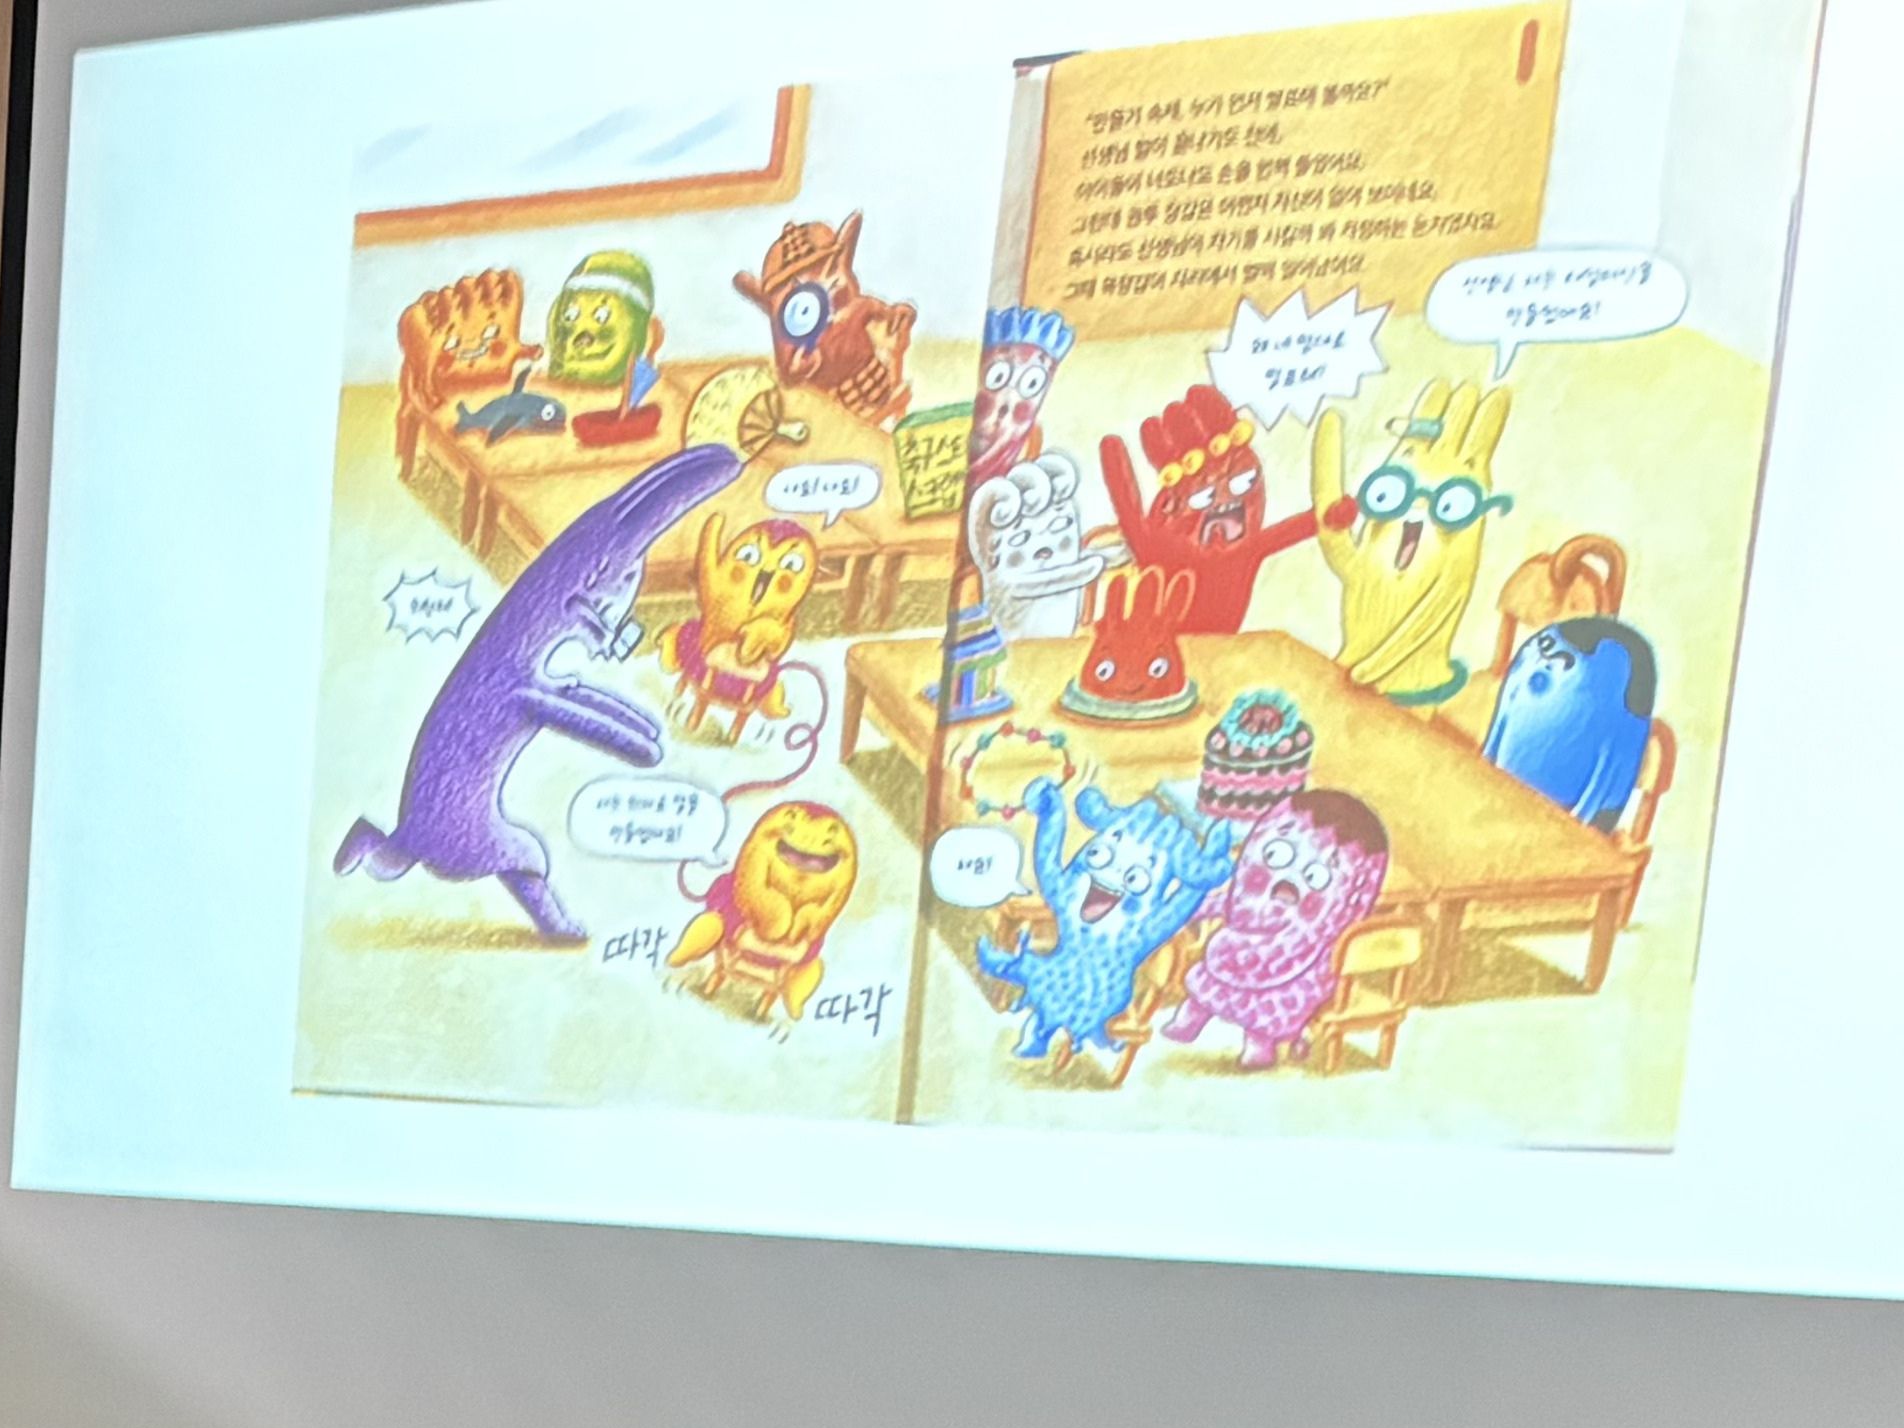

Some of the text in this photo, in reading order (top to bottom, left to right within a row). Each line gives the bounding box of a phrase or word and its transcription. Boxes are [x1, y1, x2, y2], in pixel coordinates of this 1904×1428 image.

[1228, 91, 1263, 116] 먼저
[1081, 141, 1131, 170] 선생님
[1146, 165, 1213, 190] 너도나도
[1216, 159, 1252, 185] 손을
[603, 927, 669, 966] 따각
[815, 984, 892, 1036] 따각
